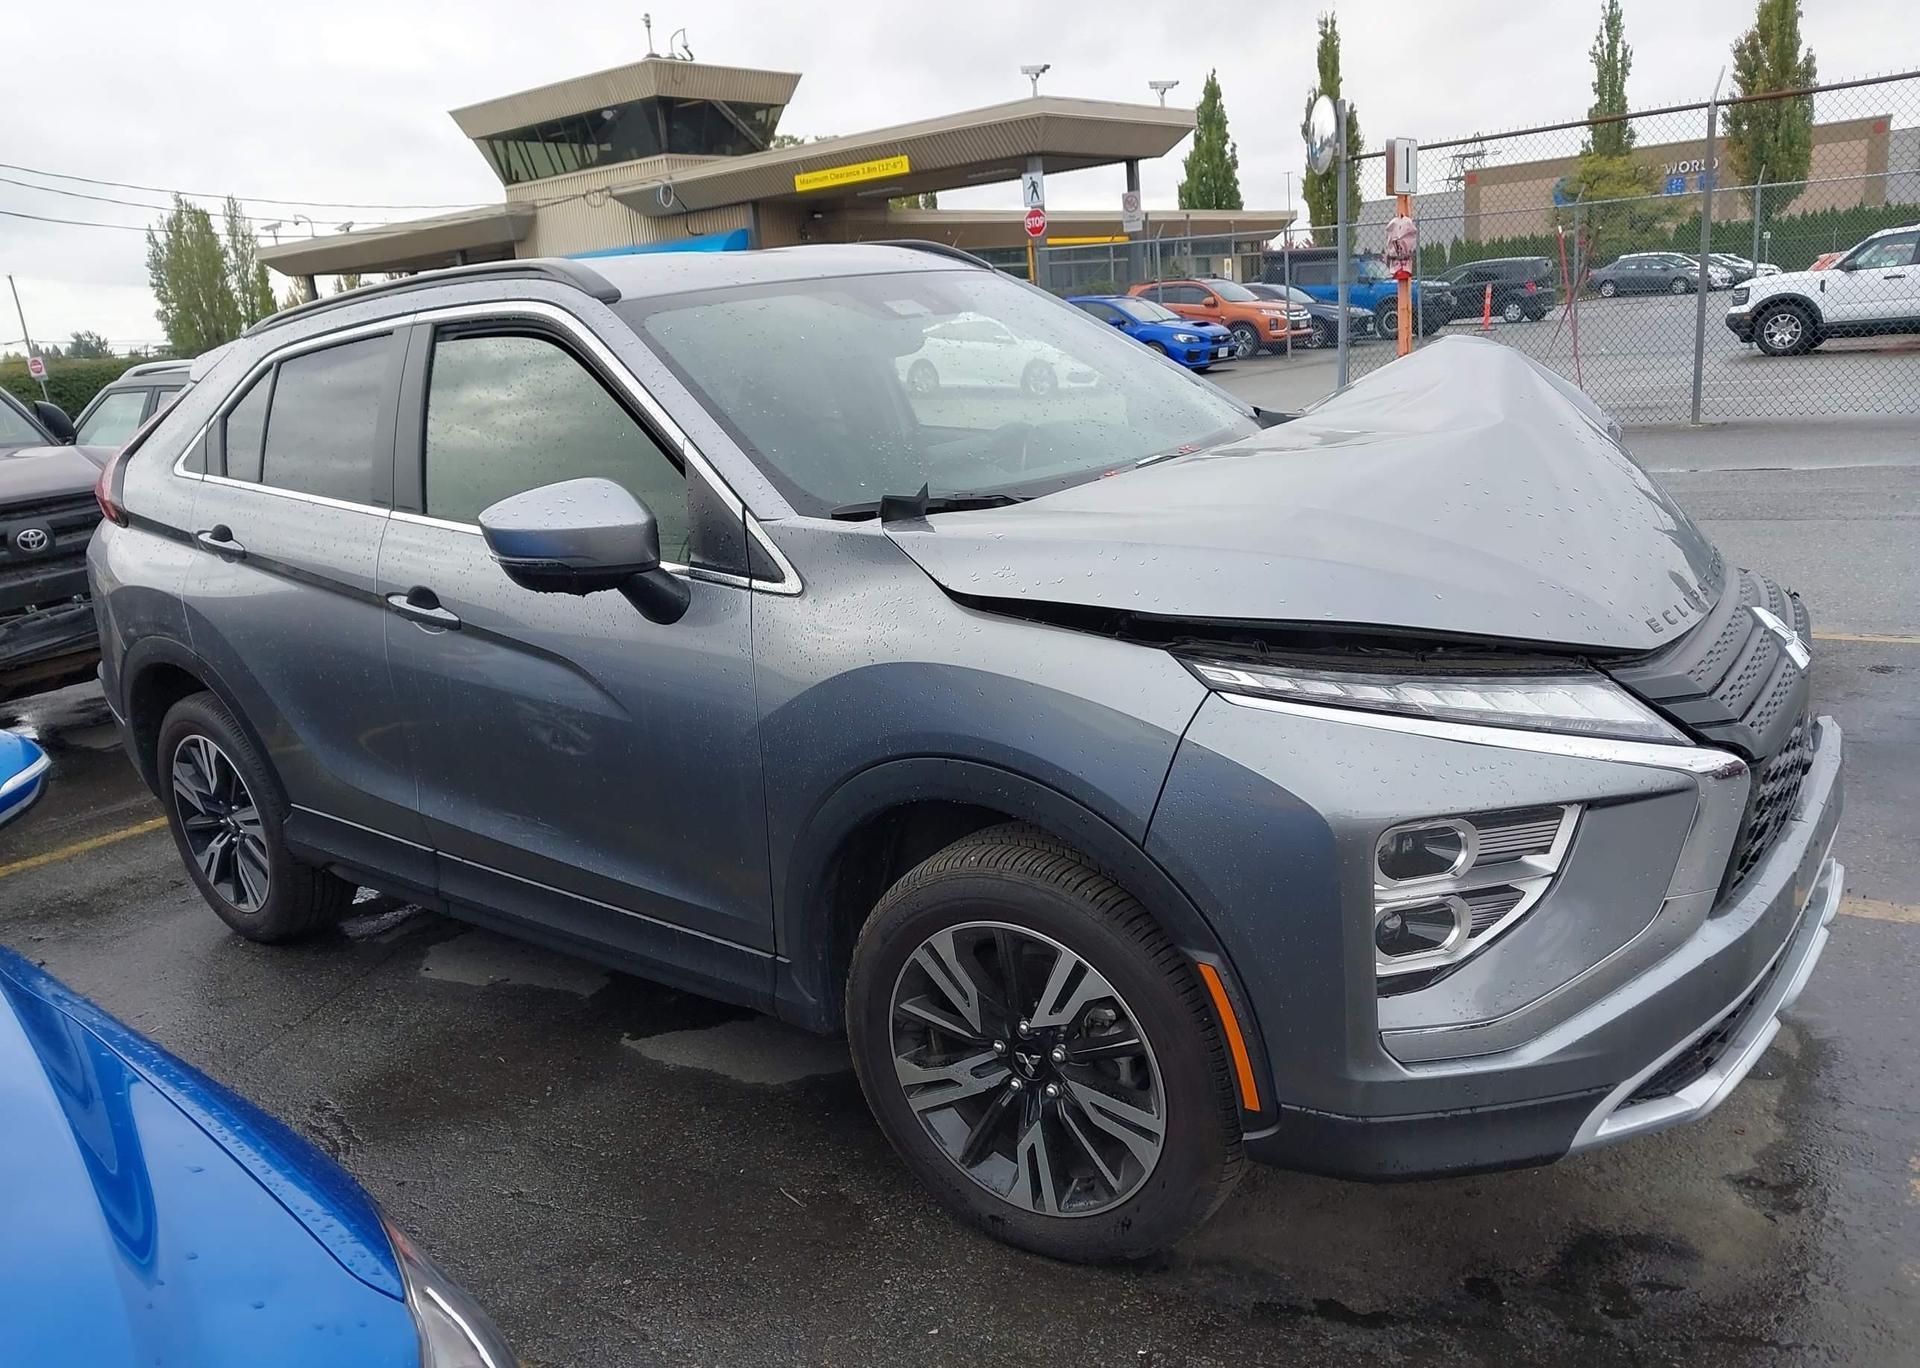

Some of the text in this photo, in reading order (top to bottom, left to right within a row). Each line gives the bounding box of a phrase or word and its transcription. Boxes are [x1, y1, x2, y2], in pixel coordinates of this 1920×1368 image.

[800, 175, 828, 185] Maximum
[829, 167, 861, 180] Clearance
[1026, 216, 1045, 229] STOP
